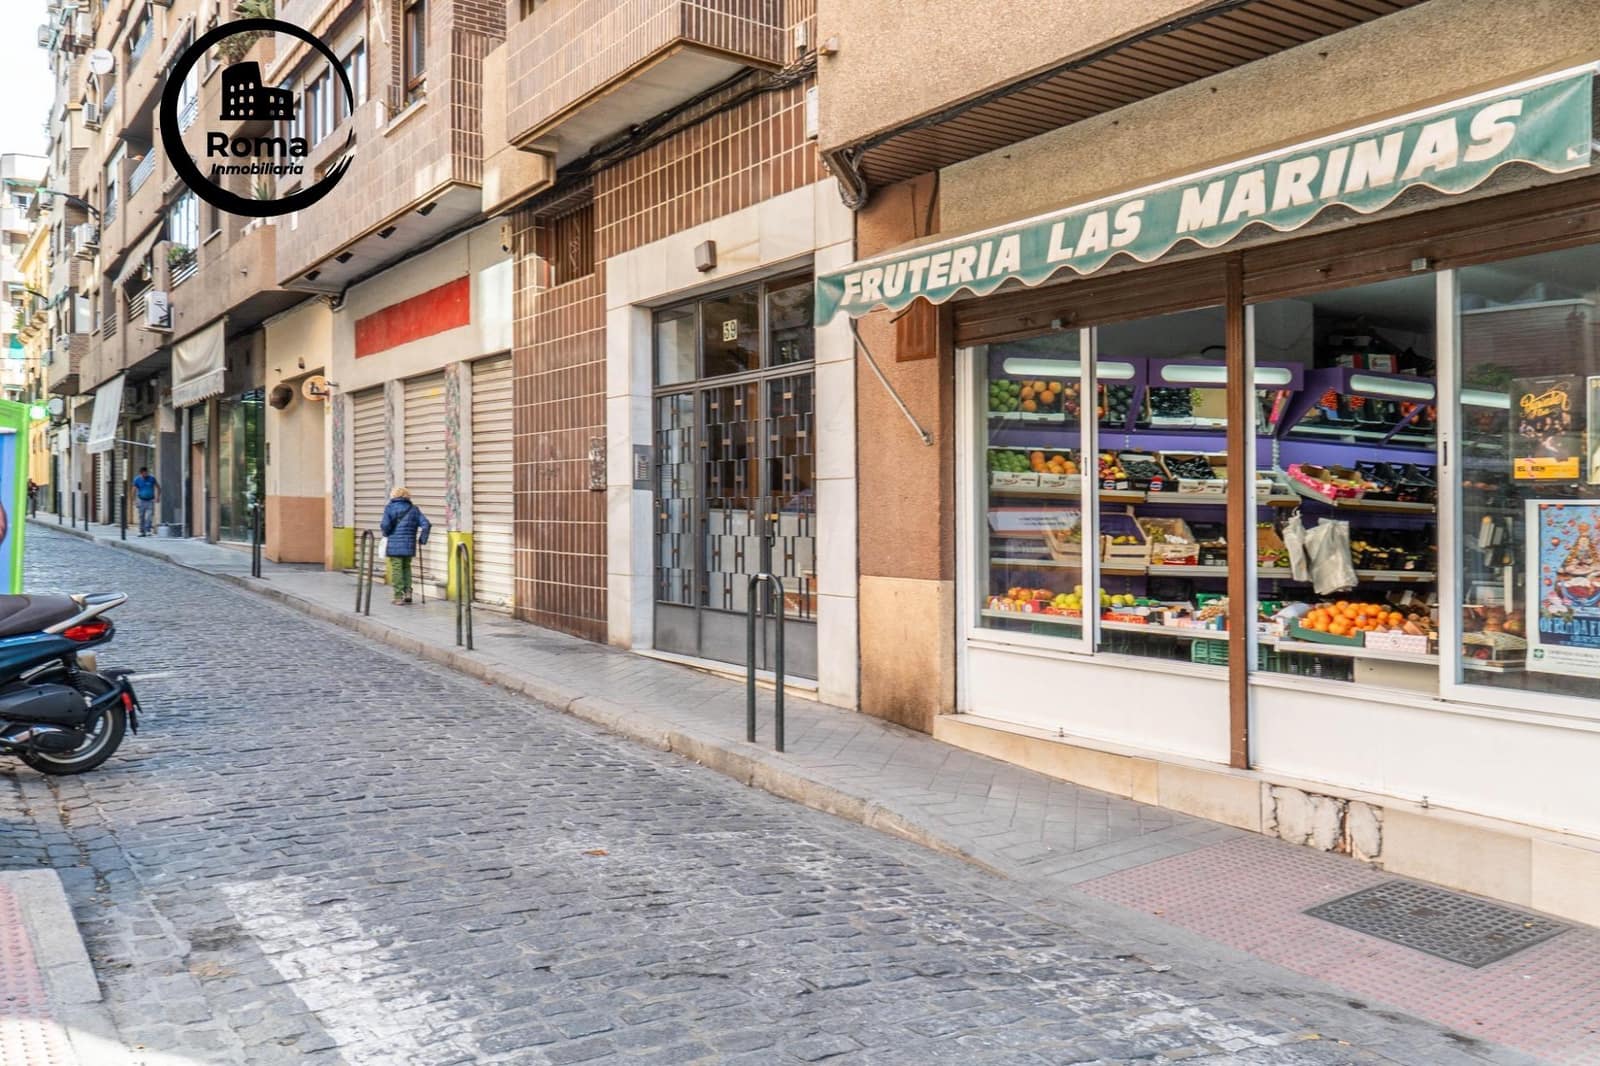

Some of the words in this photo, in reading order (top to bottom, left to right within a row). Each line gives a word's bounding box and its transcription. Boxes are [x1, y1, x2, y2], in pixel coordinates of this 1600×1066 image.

[840, 234, 1020, 305] FRUTERIA
[1046, 200, 1145, 264] LAS
[1175, 99, 1523, 234] MARINAS
